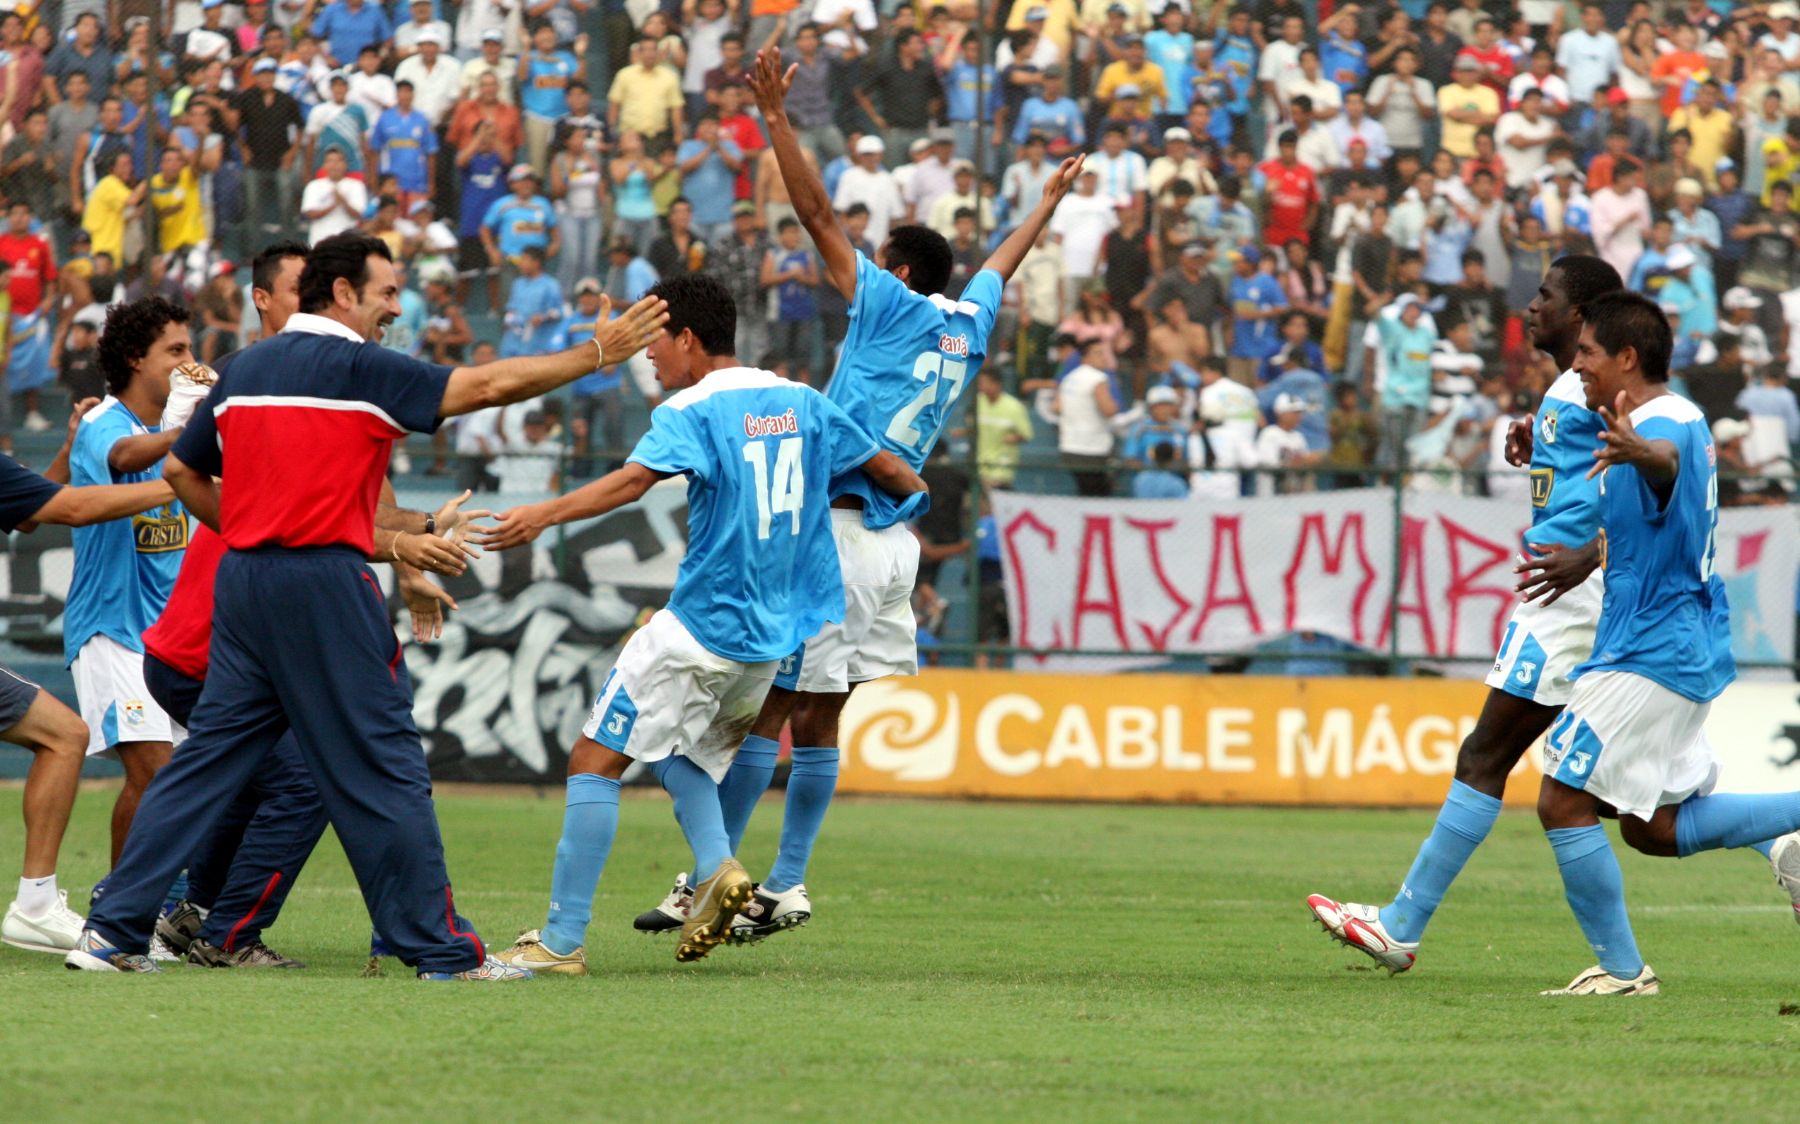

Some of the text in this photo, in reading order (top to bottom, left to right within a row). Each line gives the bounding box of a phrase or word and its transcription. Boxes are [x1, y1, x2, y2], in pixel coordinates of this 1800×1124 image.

[885, 351, 967, 453] 27
[742, 437, 804, 540] 14
[1004, 509, 1531, 664] CAJAMAR
[975, 693, 1544, 779] CABLE MÁG
